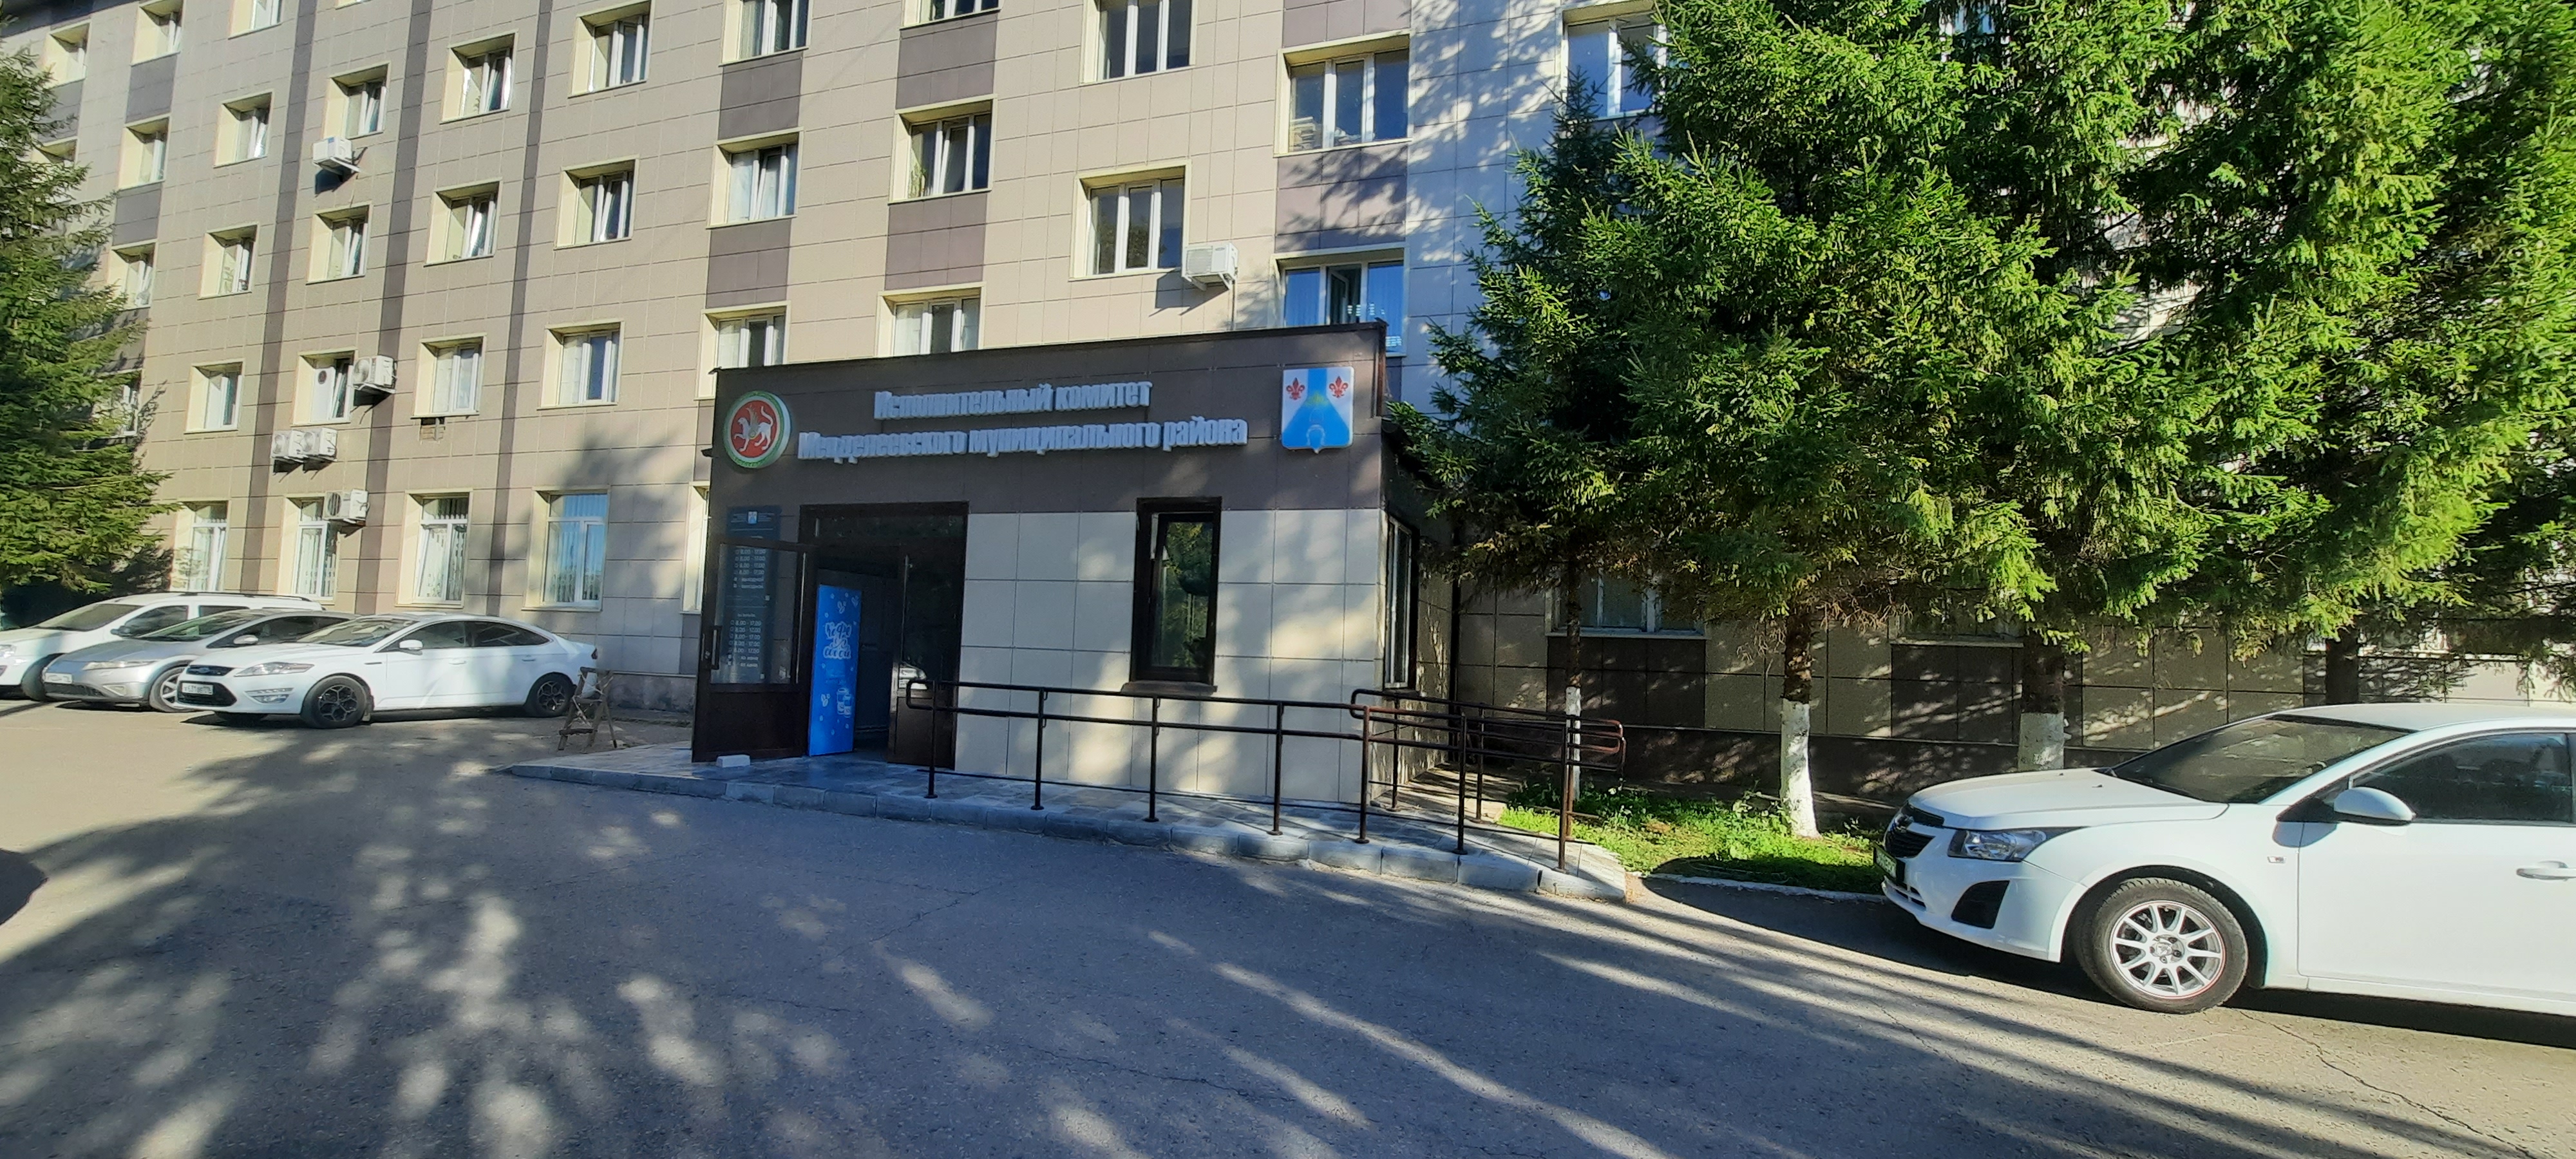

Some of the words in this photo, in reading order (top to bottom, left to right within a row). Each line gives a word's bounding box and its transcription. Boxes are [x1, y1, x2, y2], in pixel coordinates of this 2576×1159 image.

[874, 383, 1053, 419] Исполнительный
[1055, 381, 1153, 411] комитет
[798, 431, 967, 464] Менделеевского
[969, 422, 1161, 458] муниципального
[1162, 416, 1247, 451] района
